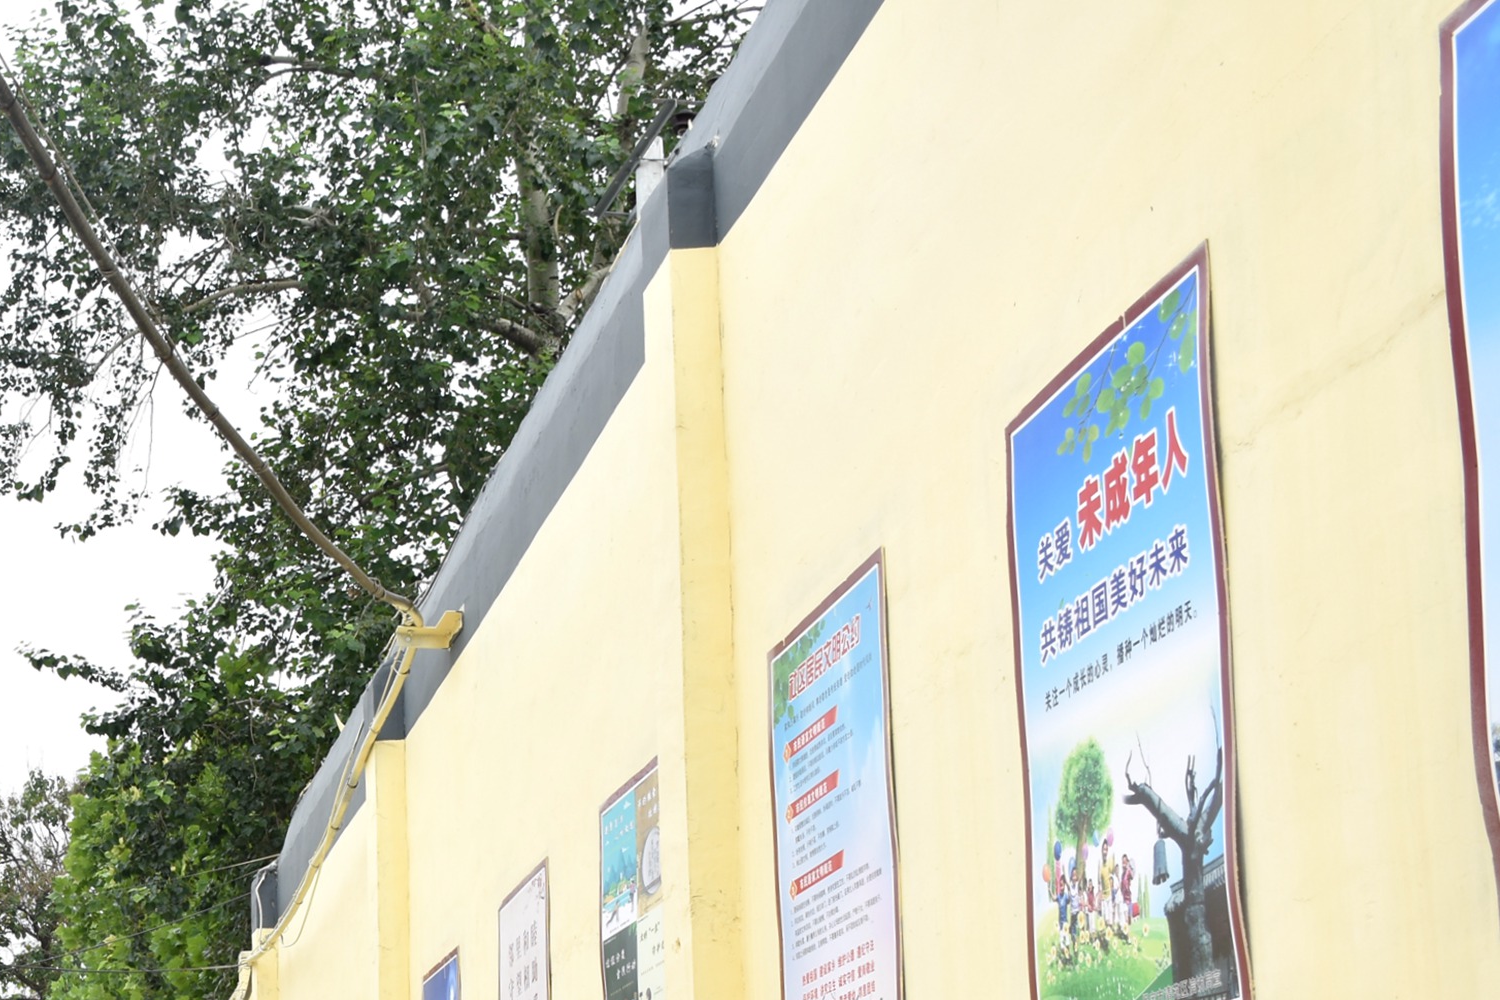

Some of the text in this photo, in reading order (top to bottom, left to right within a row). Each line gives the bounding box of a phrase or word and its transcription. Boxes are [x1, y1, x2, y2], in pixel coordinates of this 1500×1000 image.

[1037, 408, 1189, 580] 关爱 未成年人
[788, 614, 861, 702] 社区居民文明公约
[1039, 526, 1190, 664] 共铸祖国美好未来
